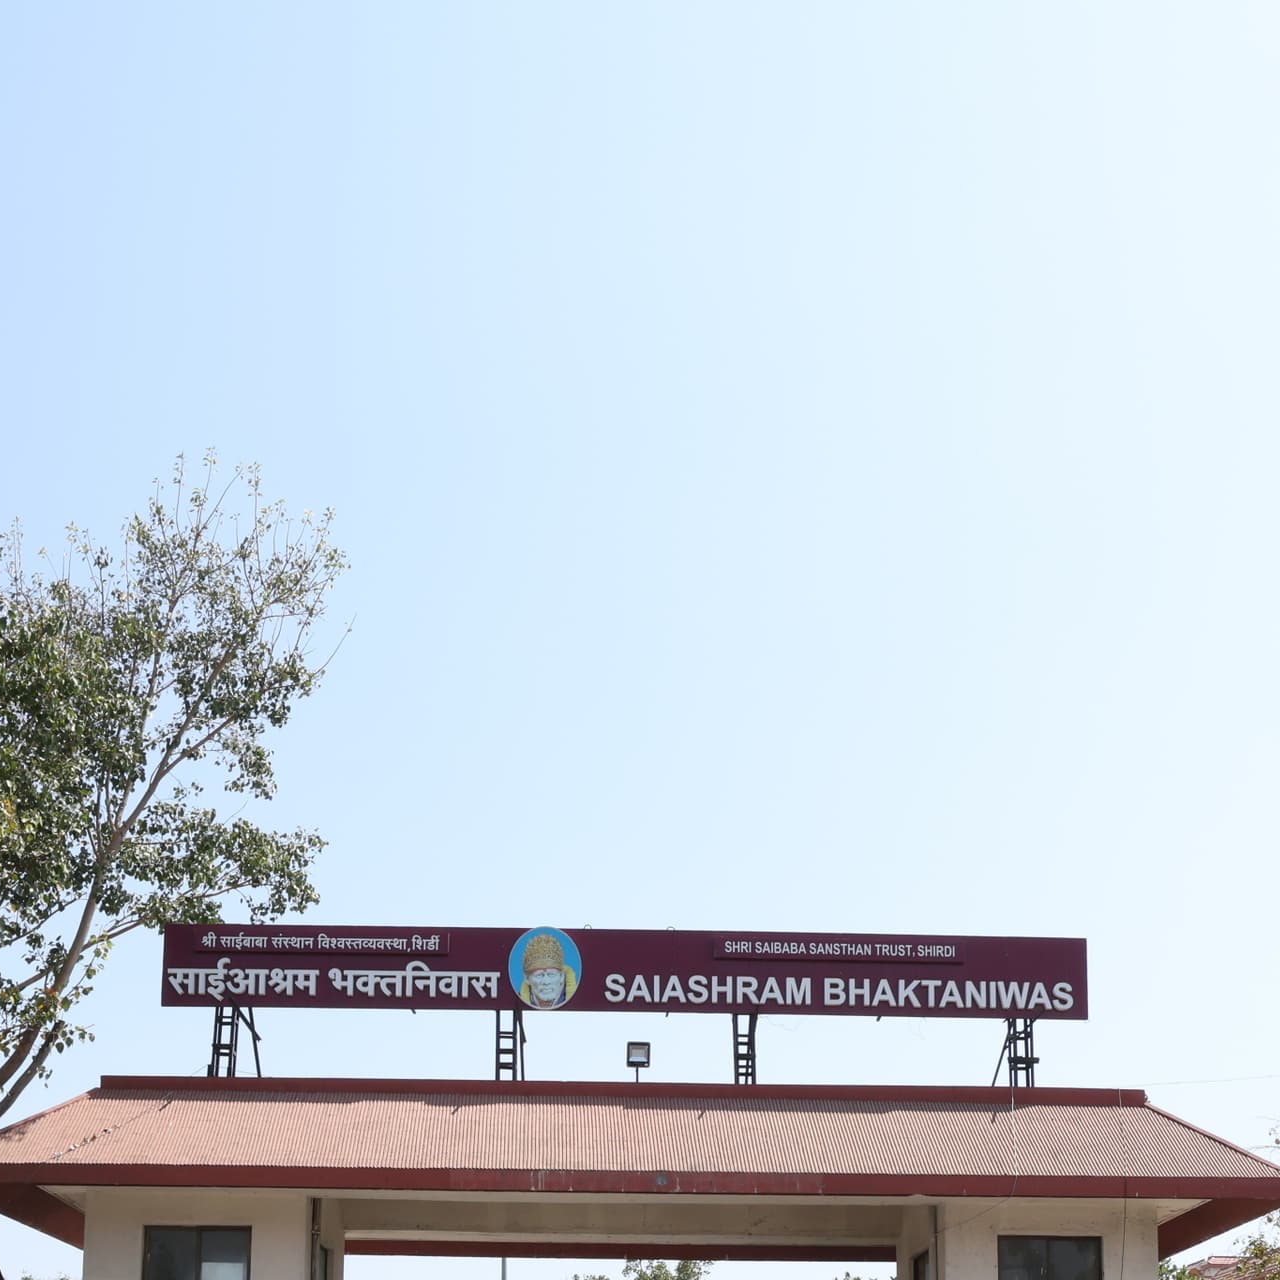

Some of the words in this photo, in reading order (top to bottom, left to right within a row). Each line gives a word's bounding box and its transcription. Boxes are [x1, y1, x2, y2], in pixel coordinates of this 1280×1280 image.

[201, 931, 217, 949] श्री
[220, 931, 268, 950] साईबाबा
[271, 933, 314, 950] संस्थान
[724, 940, 752, 953] SHRI
[755, 941, 807, 955] SAIBABA
[809, 942, 872, 956] SANSTHAN
[917, 944, 956, 958] SHIRDI
[167, 957, 320, 1001] साईआश्रम
[328, 960, 501, 998] भक्तनिवास
[604, 973, 812, 1006] SAIASHRAM
[823, 977, 1074, 1012] BHAKTANIWAS
